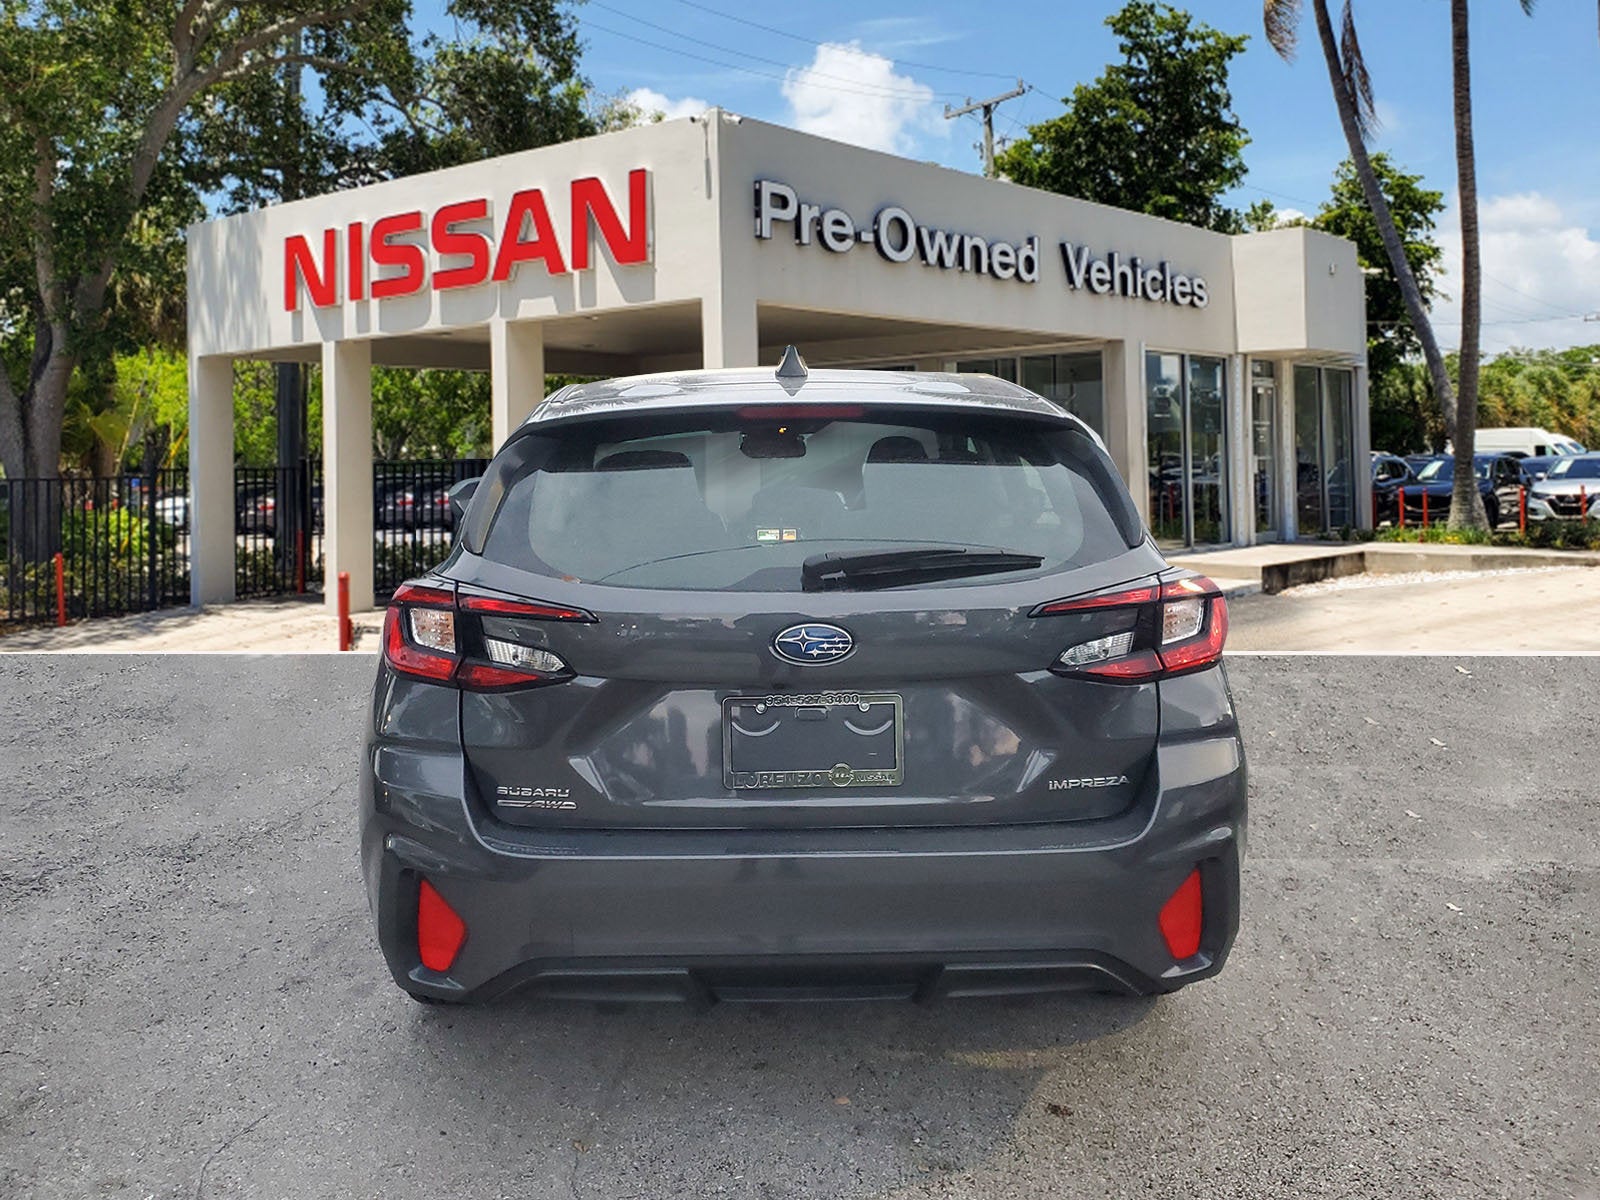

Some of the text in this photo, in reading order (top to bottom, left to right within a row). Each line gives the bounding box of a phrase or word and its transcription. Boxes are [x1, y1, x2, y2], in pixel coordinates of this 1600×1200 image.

[284, 168, 648, 312] NISSAN
[754, 180, 1208, 309] Pre-Owned Vehicles
[1048, 775, 1129, 791] IMPREZA
[496, 785, 570, 798] SUBARU
[526, 800, 577, 810] AWD
